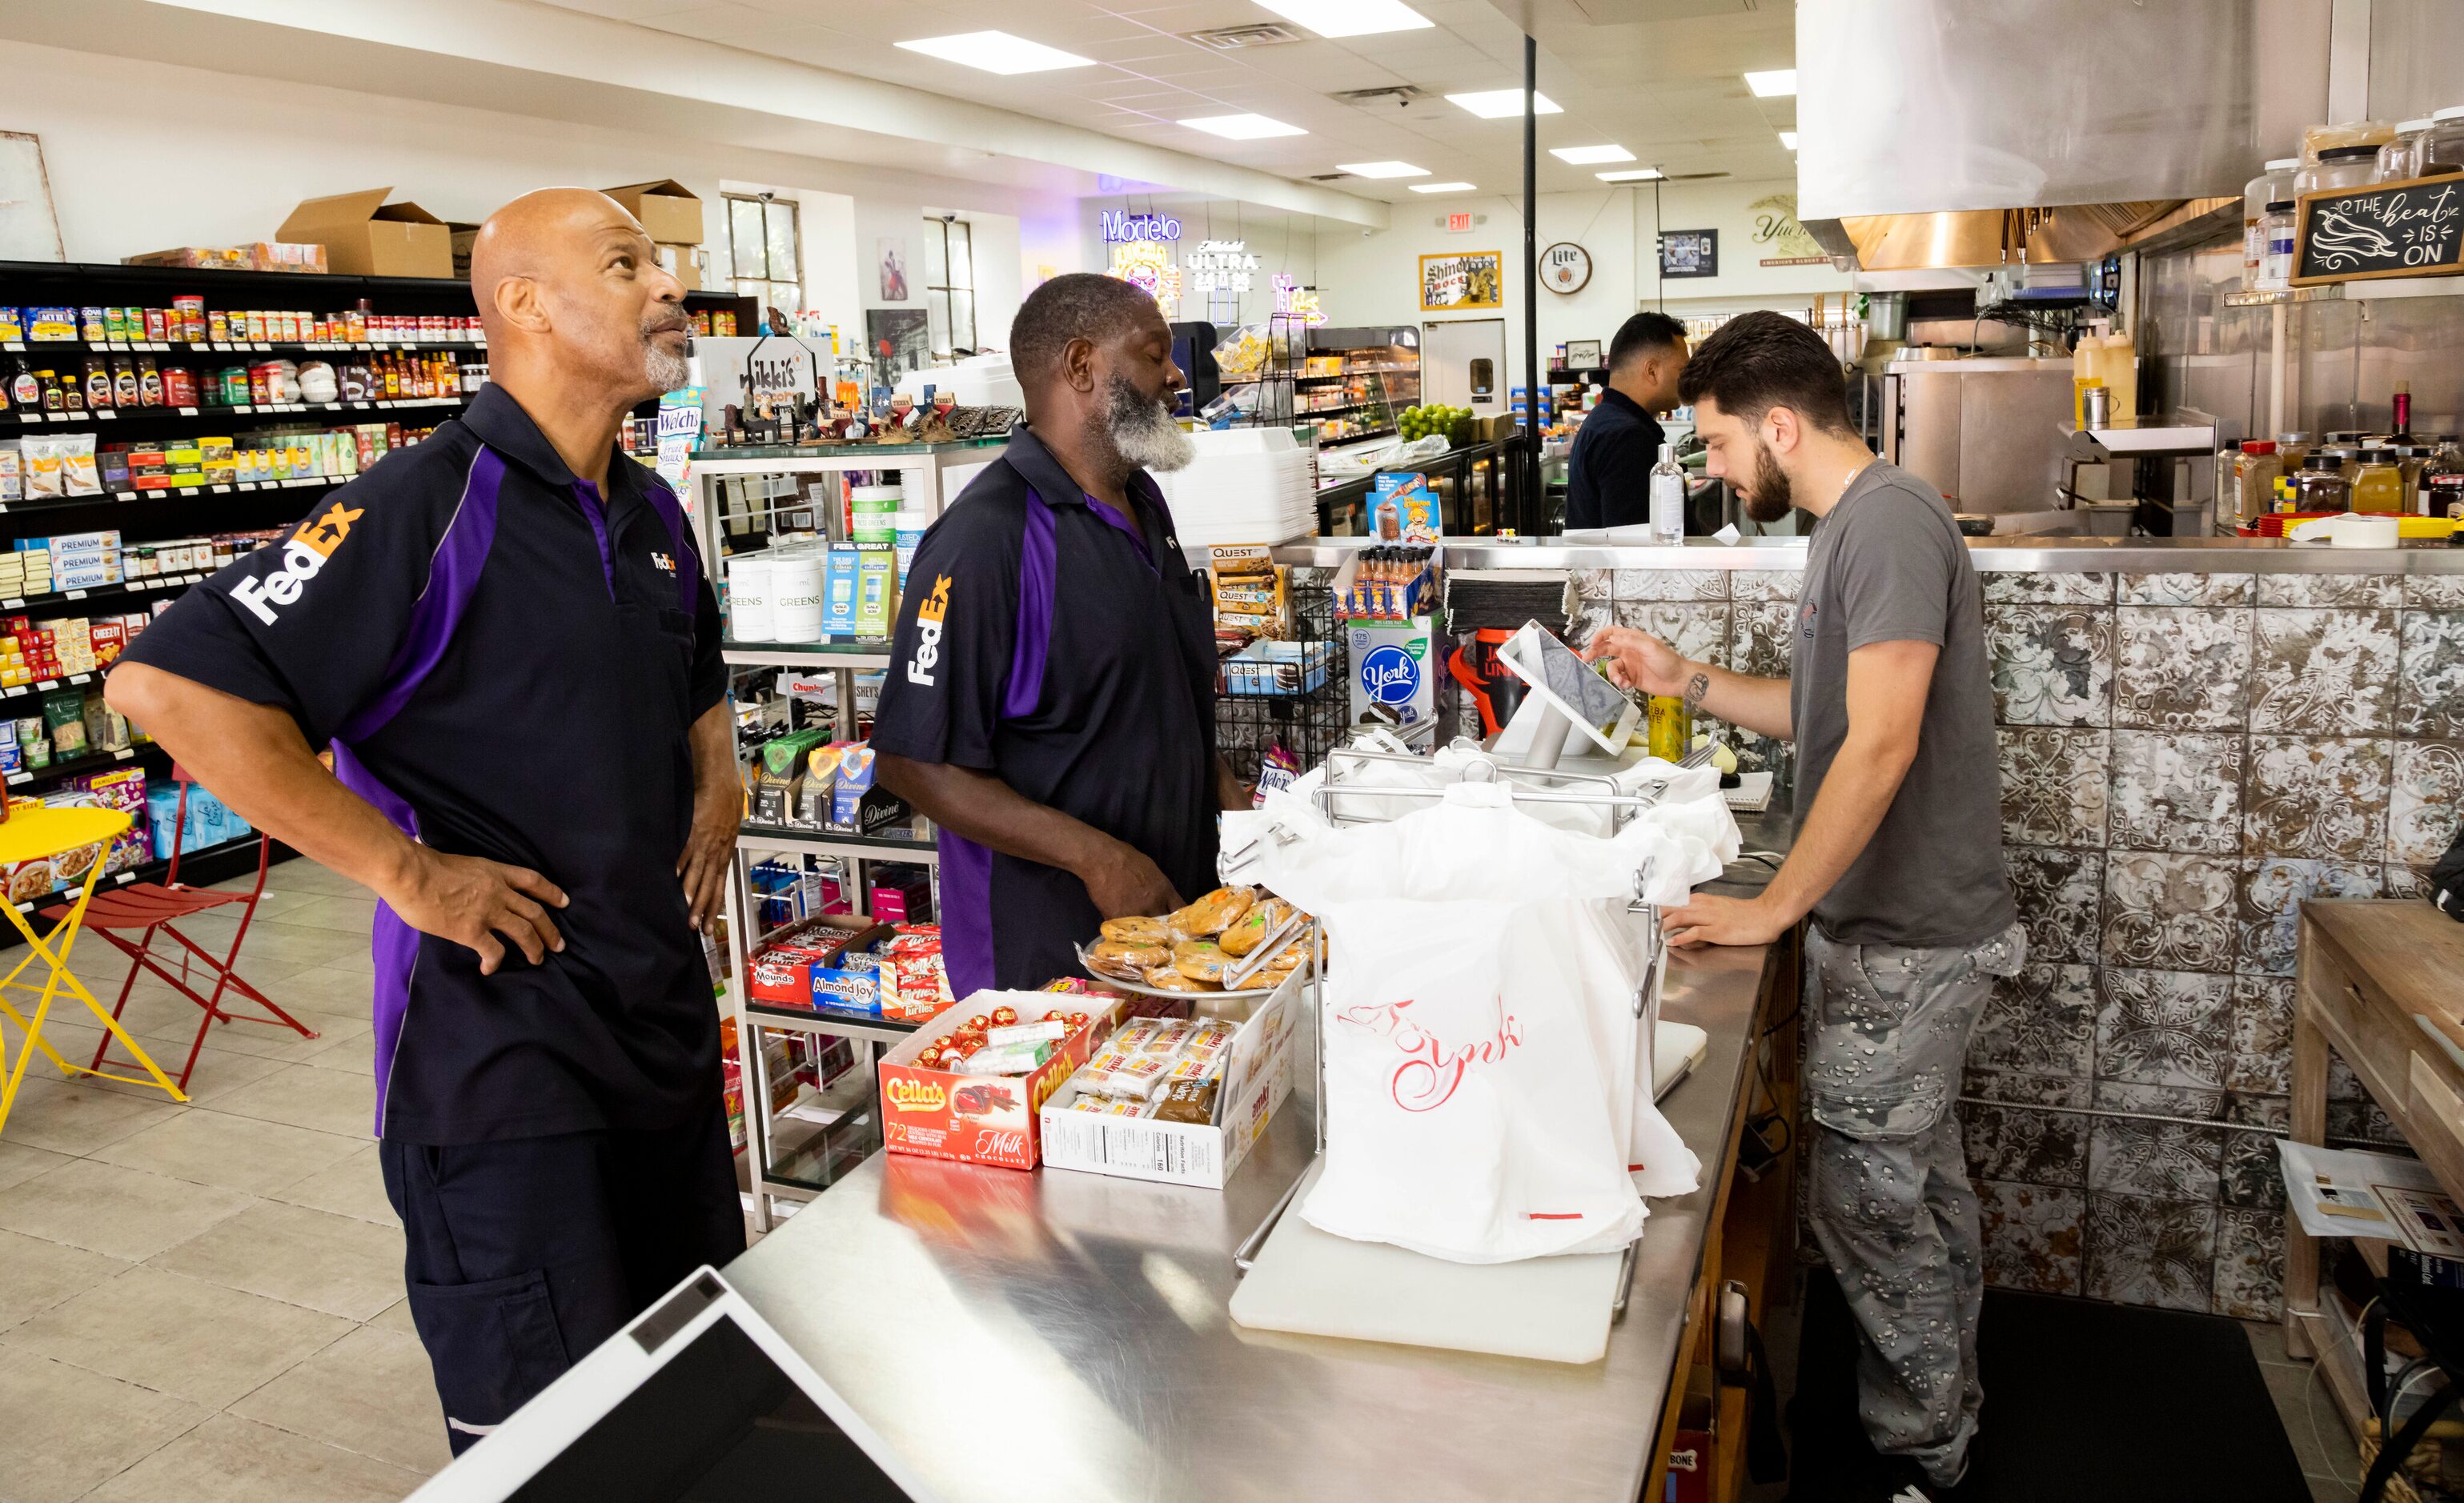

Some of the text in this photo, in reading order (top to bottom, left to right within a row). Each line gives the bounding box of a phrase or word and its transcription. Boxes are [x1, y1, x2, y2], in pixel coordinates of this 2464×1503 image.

[2354, 185, 2455, 227] THE heat
[1102, 210, 1182, 243] Modelo
[1450, 214, 1471, 230] EXIT
[2420, 224, 2437, 242] IS
[1552, 250, 1577, 267] Lite
[2404, 242, 2443, 265] ON
[1188, 253, 1259, 271] ULTRA
[1434, 275, 1465, 291] BOCK
[740, 358, 797, 389] nikki's
[659, 410, 699, 432] Welch's
[62, 538, 99, 550] PREMIUM
[857, 543, 889, 551] GREAT
[1214, 548, 1253, 558] QUEST
[63, 556, 101, 568] PREMIUM
[229, 502, 366, 627] FedEx
[66, 573, 103, 585] PREMIUM
[780, 595, 820, 607] GREENS
[1219, 591, 1248, 600] QUEST
[907, 573, 952, 687] FedEx
[1362, 656, 1416, 703] York
[793, 682, 825, 695] Chunky
[94, 777, 114, 787] FAMILY
[836, 778, 867, 791] Divine
[864, 802, 899, 825] Divine
[756, 971, 794, 984] Mounds
[813, 977, 874, 1002] Almond Joy
[901, 1003, 934, 1016] Turtles
[1208, 1032, 1226, 1048] amki
[1106, 1055, 1126, 1072] amki
[886, 1077, 946, 1104] Cella's
[1252, 1080, 1269, 1118] amki
[888, 1121, 907, 1142] 72
[975, 1129, 1024, 1157] Milk
[974, 1153, 1026, 1164] CHOCOLATE
[1156, 1158, 1164, 1172] 160
[1670, 1454, 1694, 1467] BONE
